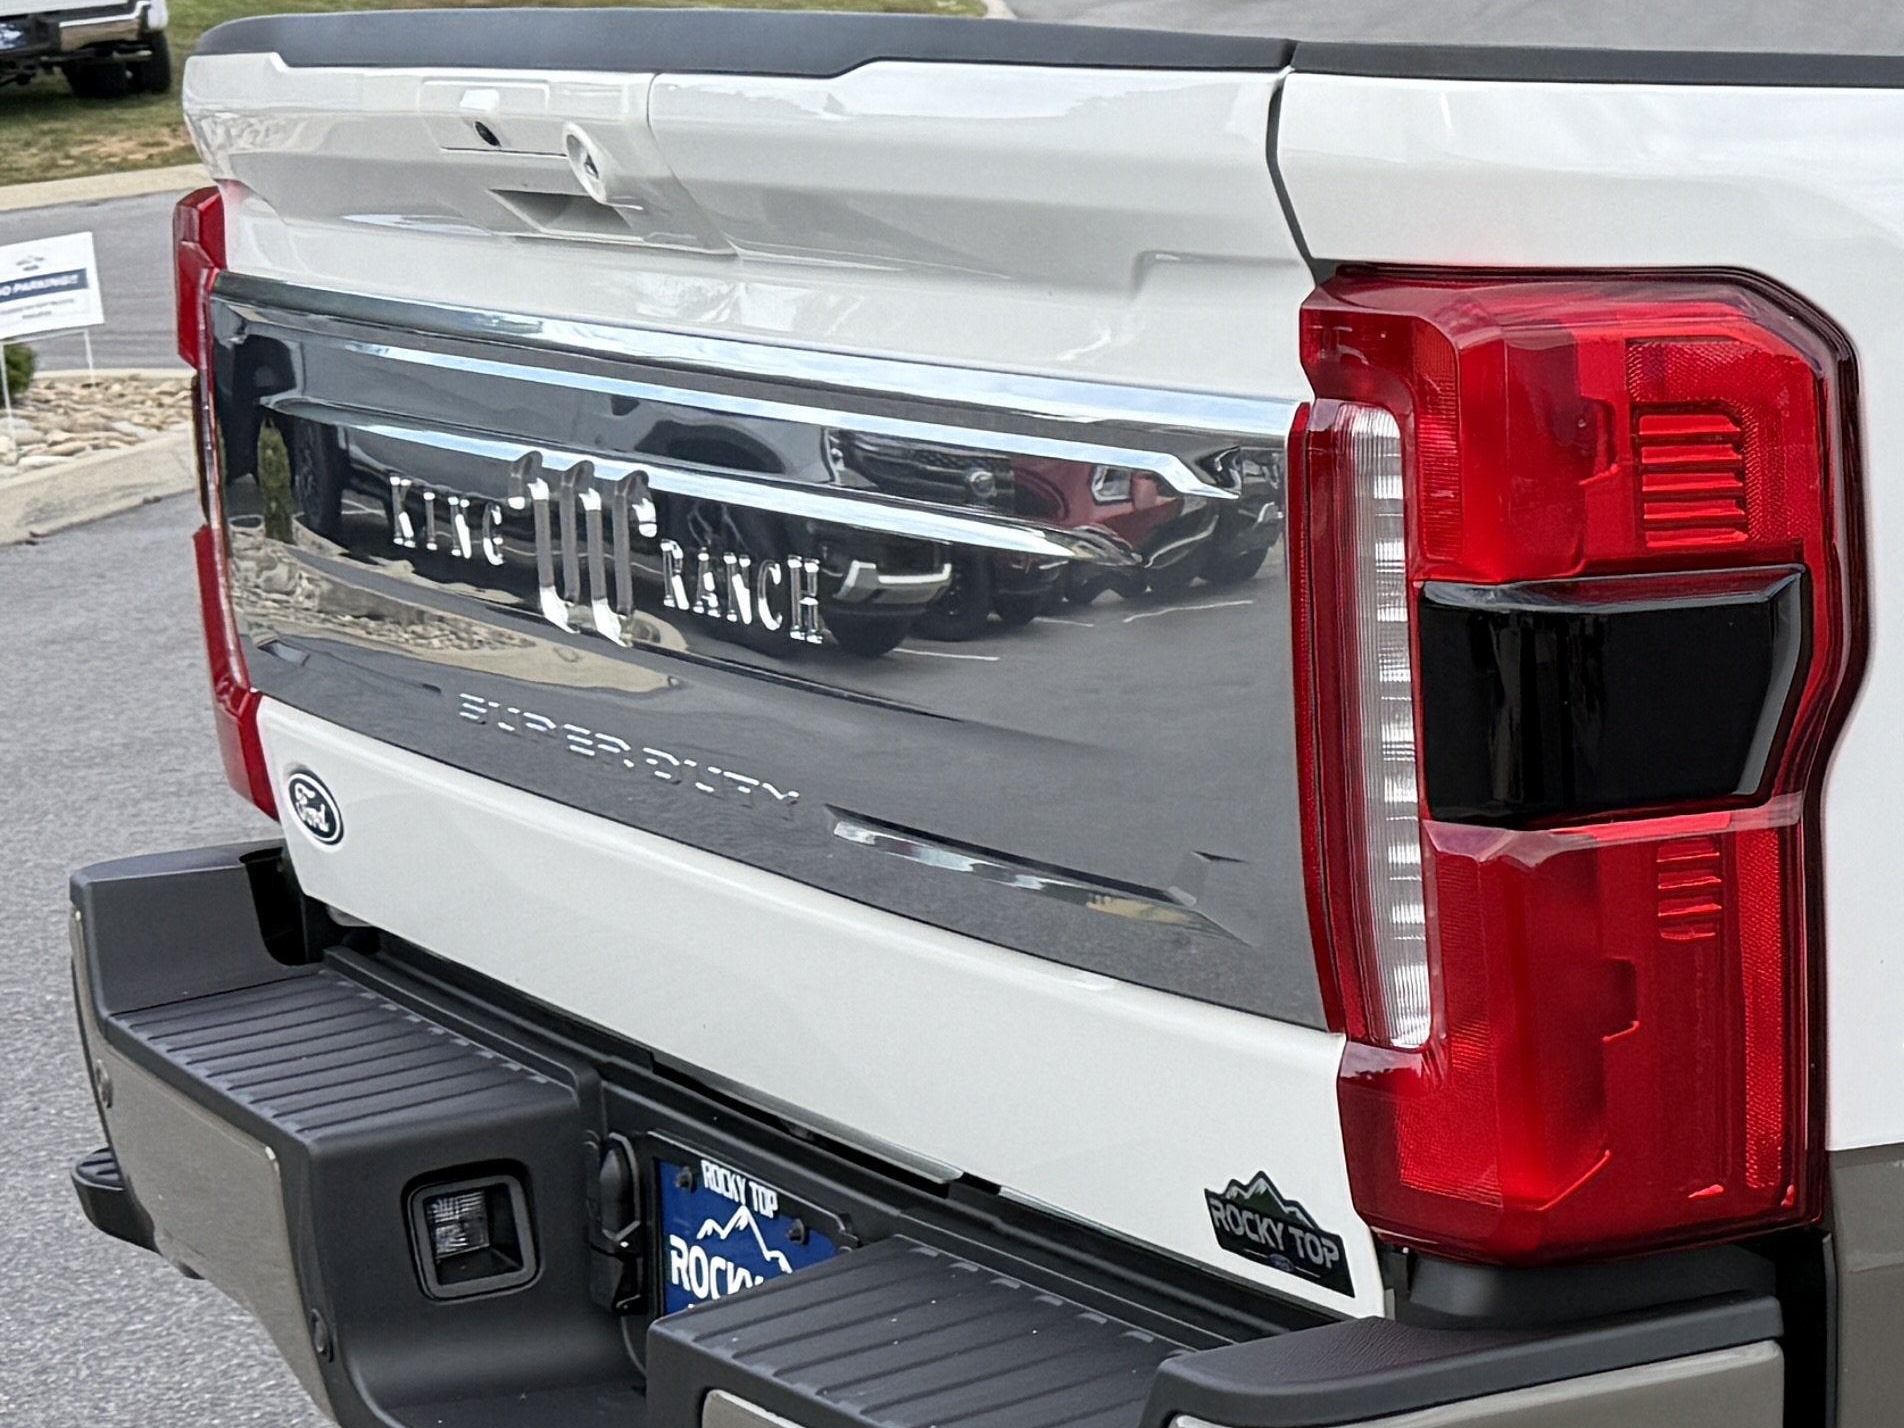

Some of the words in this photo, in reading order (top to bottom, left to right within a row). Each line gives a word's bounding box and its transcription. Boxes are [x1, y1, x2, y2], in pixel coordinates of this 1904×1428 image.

[389, 474, 504, 566] KING
[660, 539, 823, 644] RANCH
[459, 693, 635, 770] SUPER
[642, 746, 800, 814] DUTY
[295, 782, 330, 833] Ford
[701, 1159, 747, 1205] ROCKY
[748, 1180, 779, 1219] TOP
[669, 1234, 764, 1300] ROCK
[1208, 1197, 1285, 1252] ROCKY
[1287, 1226, 1341, 1269] TOP
